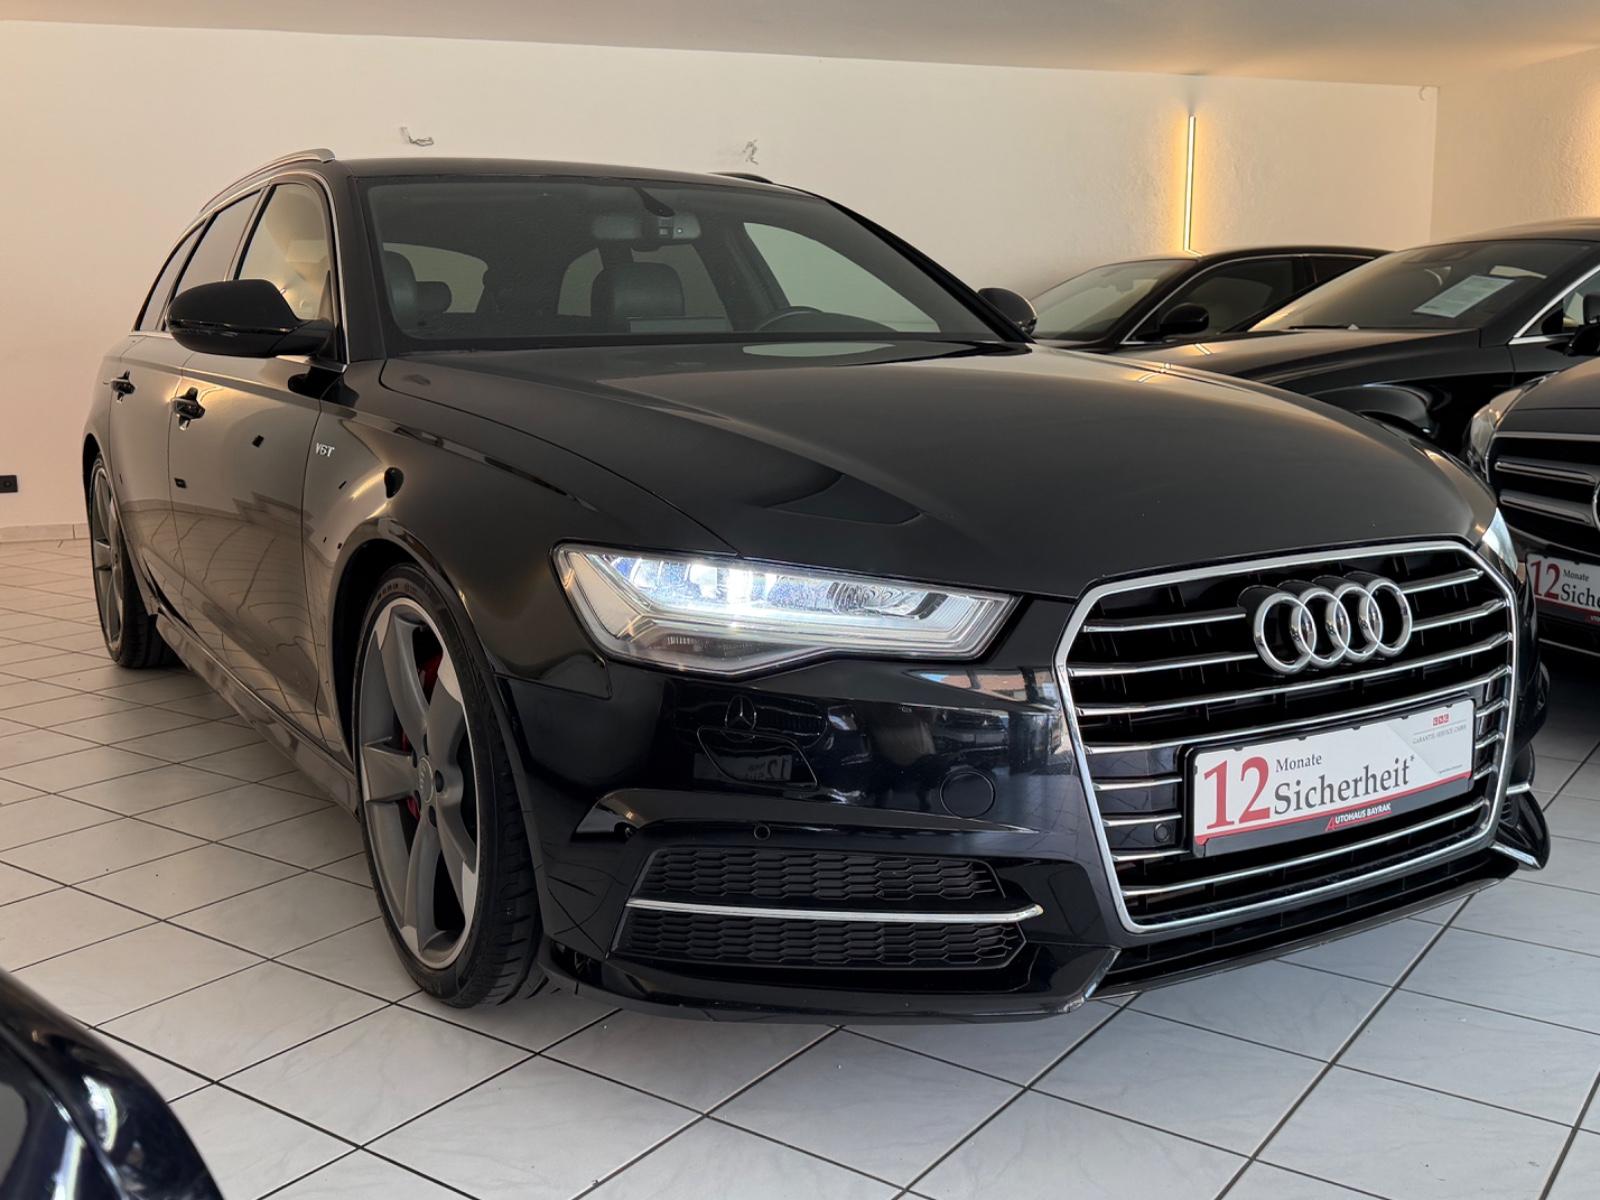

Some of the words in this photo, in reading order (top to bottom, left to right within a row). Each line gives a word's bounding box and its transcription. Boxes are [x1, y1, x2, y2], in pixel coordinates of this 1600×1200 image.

[315, 442, 335, 457] V6T
[1531, 560, 1560, 600] 12
[1275, 754, 1322, 772] Monate
[1204, 756, 1270, 829] 12
[1367, 803, 1392, 817] BAYRAK
